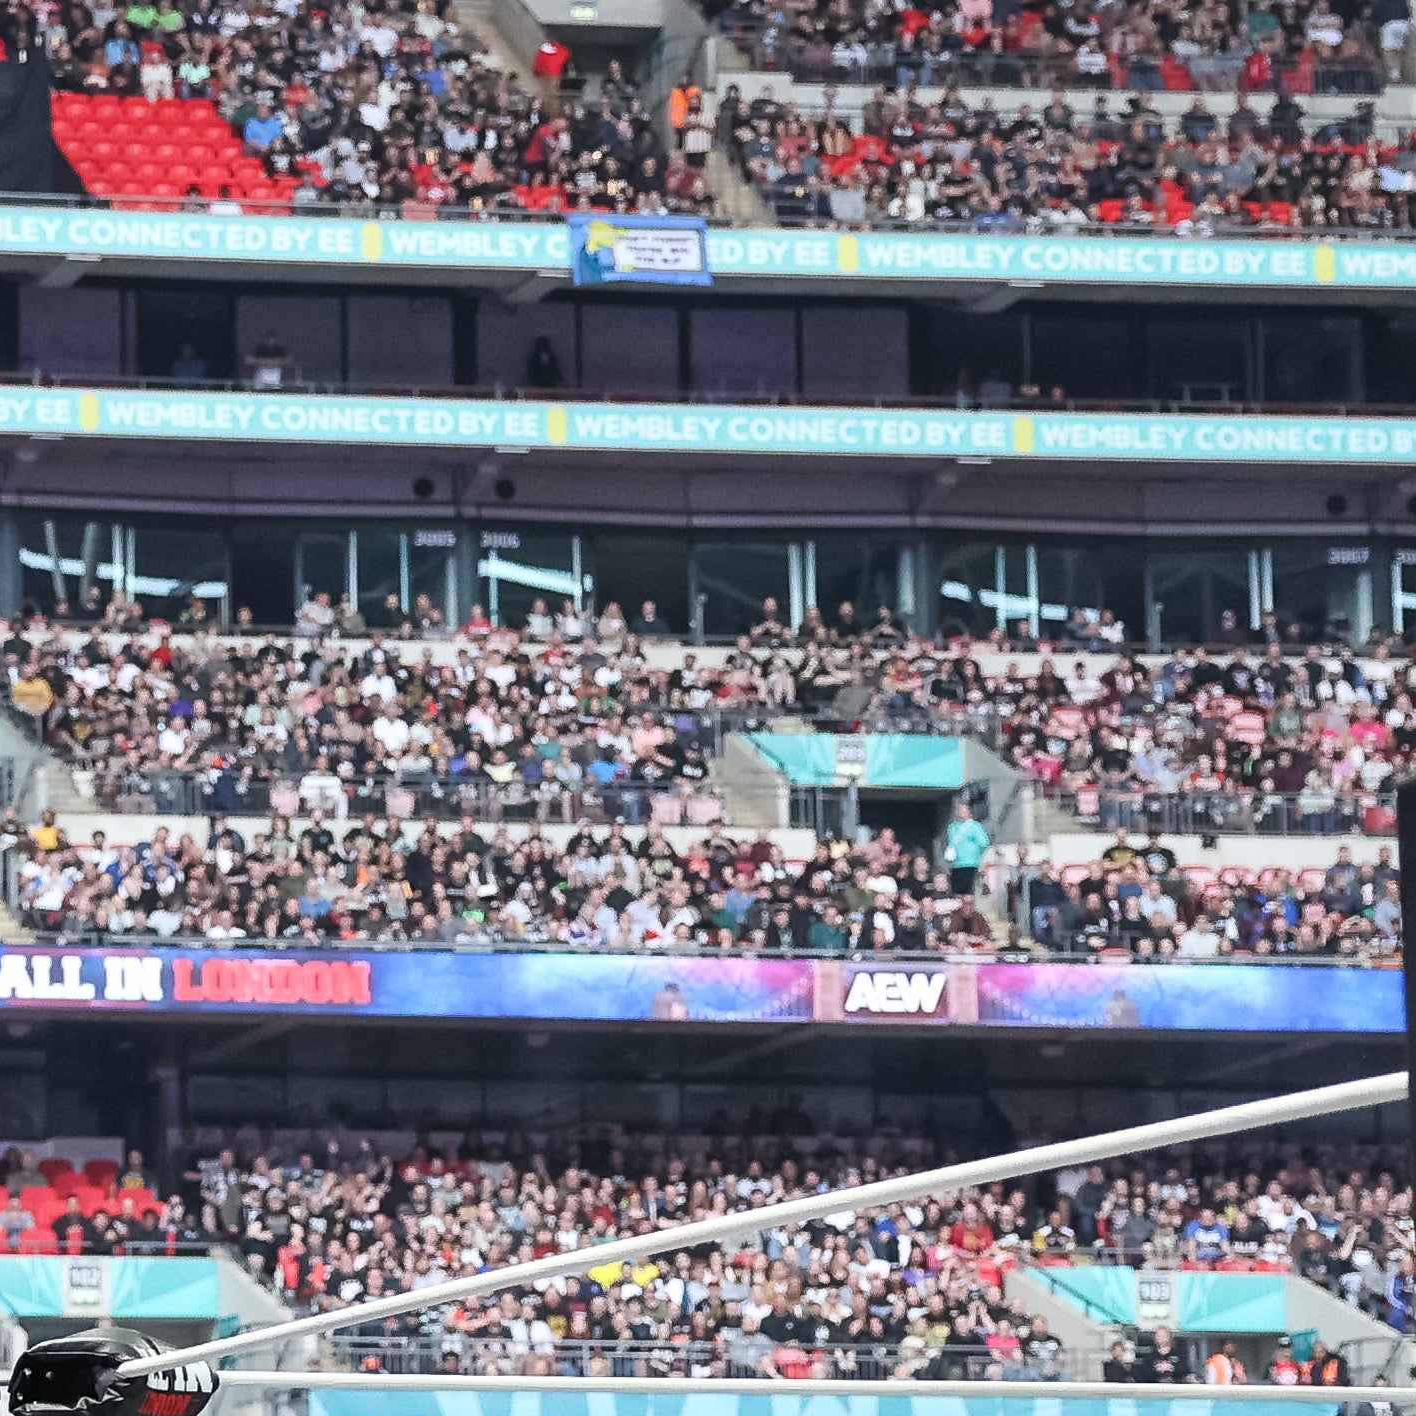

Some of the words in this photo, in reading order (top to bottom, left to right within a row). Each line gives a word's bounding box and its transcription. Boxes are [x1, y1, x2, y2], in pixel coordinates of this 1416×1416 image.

[68, 219, 268, 249] CONNECTED
[271, 226, 313, 251] BY
[318, 227, 354, 253] EE
[389, 230, 539, 258] WEMBLEY
[747, 239, 789, 264] BY
[794, 240, 829, 267] EE
[866, 241, 1014, 269] WEMBLEY
[1022, 245, 1219, 274] CONNECTED
[1225, 250, 1264, 275] BY
[1272, 250, 1304, 277] EE
[36, 398, 71, 424] EE
[106, 401, 254, 429] WEMBLEY
[261, 405, 454, 434] CONNECTED
[459, 411, 498, 435] BY
[505, 411, 538, 437] EE
[576, 415, 720, 440] WEMBLEY
[729, 417, 920, 445] CONNECTED
[926, 422, 965, 446] BY
[972, 422, 1004, 446] EE
[1042, 424, 1186, 449] WEMBLEY
[1196, 426, 1386, 453] CONNECTED
[1394, 430, 1416, 453] B
[104, 956, 163, 1001] IN
[172, 959, 371, 1004] LONDON
[844, 972, 946, 1013] AEW
